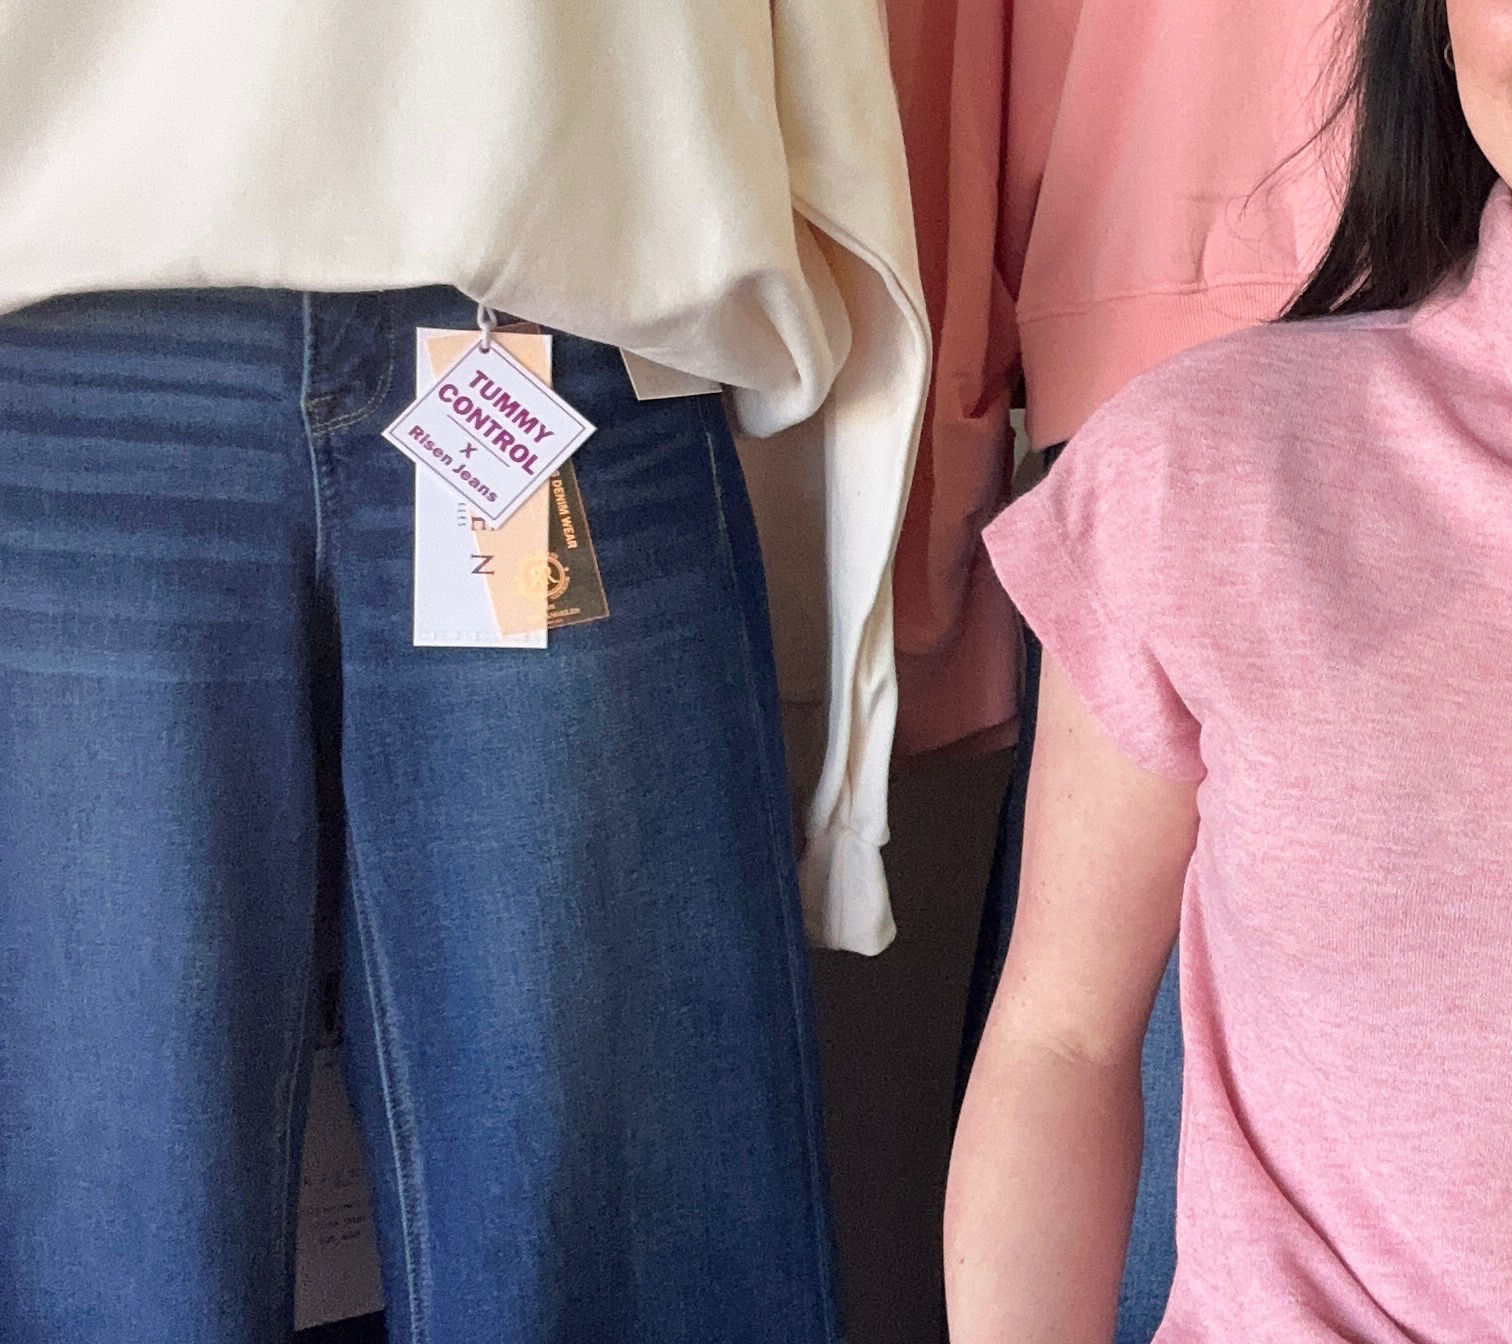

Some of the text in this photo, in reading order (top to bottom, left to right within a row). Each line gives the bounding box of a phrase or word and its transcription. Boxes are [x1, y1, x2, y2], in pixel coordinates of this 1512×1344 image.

[438, 383, 539, 475] CONTROL
[469, 370, 555, 443] TUMMY
[408, 425, 498, 502] Risen Jeans
[551, 479, 569, 516] DENIM
[562, 515, 578, 549] WEAR
